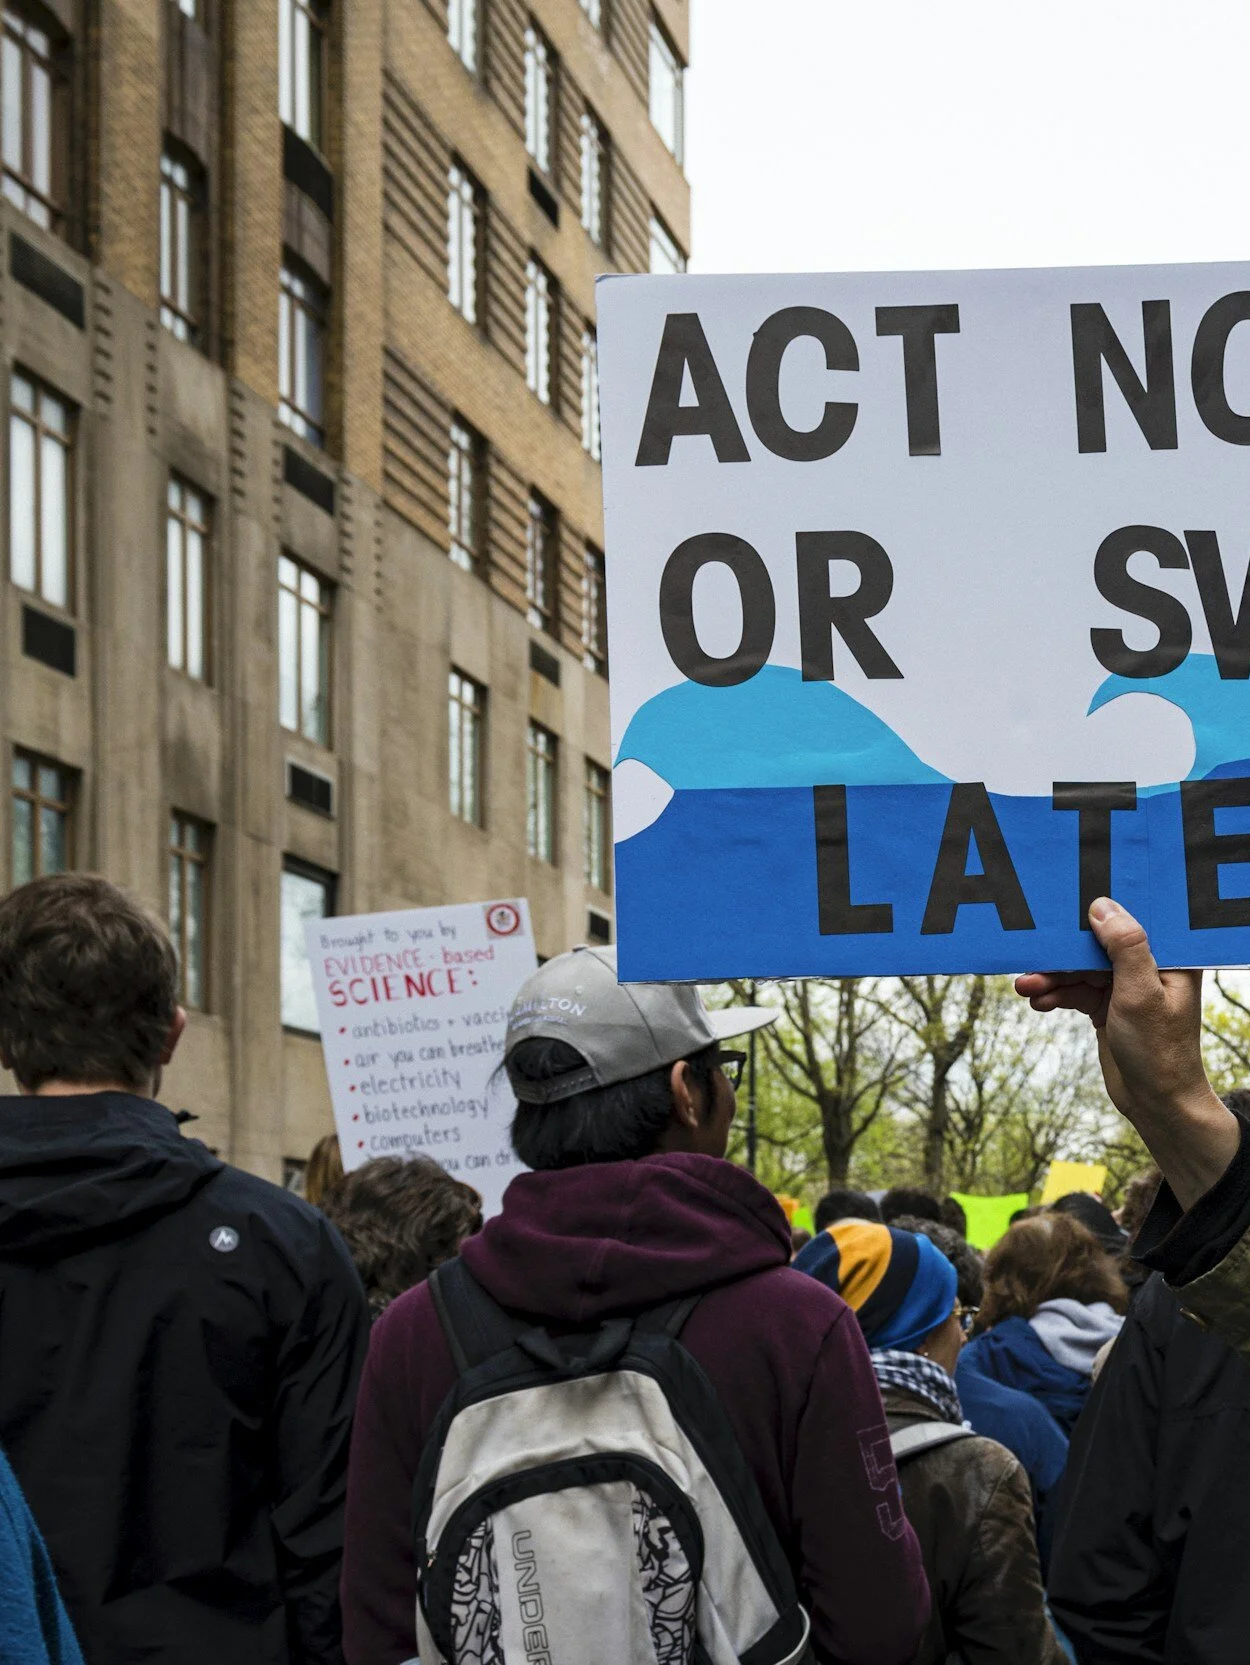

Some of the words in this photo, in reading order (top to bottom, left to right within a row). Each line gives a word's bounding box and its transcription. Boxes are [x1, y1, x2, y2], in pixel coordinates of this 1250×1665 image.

[635, 304, 960, 466] ACT
[659, 530, 904, 687] OR
[319, 928, 375, 951] Brought
[384, 926, 399, 943] to
[407, 928, 434, 944] you
[437, 919, 457, 940] by
[323, 947, 425, 978] EVIDENCE
[441, 944, 495, 965] based
[328, 967, 478, 1007] SCIENCE:
[352, 1012, 440, 1039] antibiotics
[354, 1052, 379, 1069] air
[387, 1050, 414, 1069] you
[418, 1045, 445, 1061] can
[360, 1067, 462, 1096] electricity
[362, 1097, 489, 1125] biotechnology
[370, 1123, 461, 1151] computers
